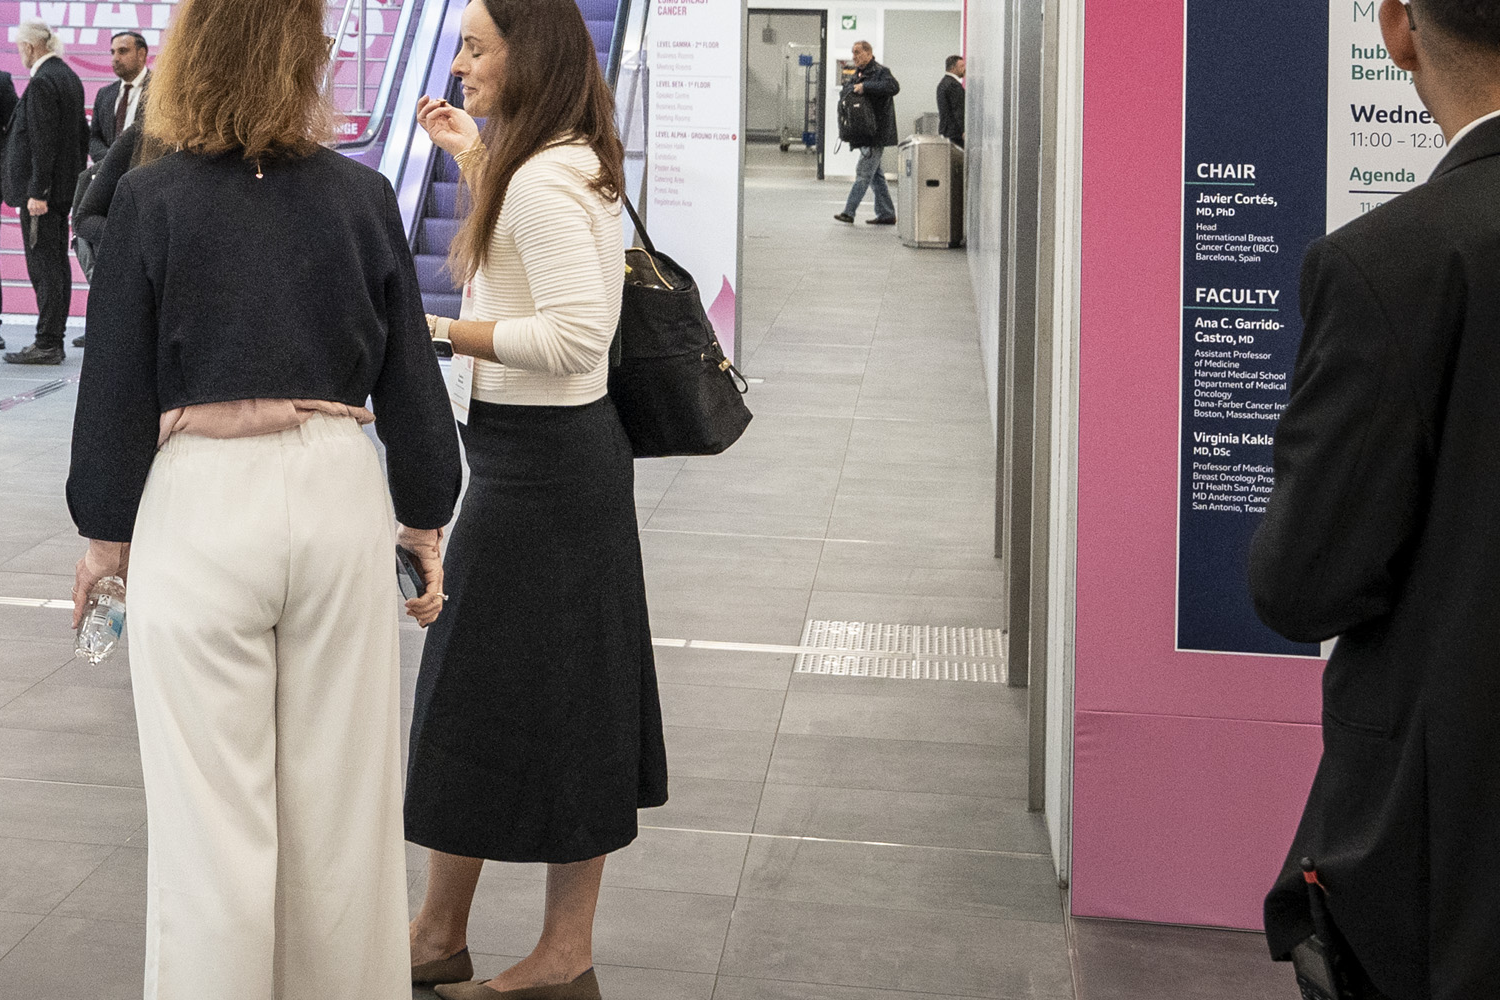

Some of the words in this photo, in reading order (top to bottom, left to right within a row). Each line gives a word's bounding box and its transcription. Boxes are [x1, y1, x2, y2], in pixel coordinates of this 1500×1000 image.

[657, 6, 687, 16] CANCER
[1352, 44, 1391, 59] hub
[1351, 65, 1414, 84] Berlin,
[1350, 132, 1392, 147] 11:00
[1410, 133, 1444, 149] 12:0
[1197, 163, 1256, 179] CHAIR
[1350, 167, 1415, 185] Agenda
[1196, 193, 1232, 204] Javier
[1235, 193, 1278, 207] Cortés,
[1196, 208, 1214, 218] MD,
[1216, 208, 1235, 217] PhD
[1196, 223, 1217, 231] Head
[1196, 233, 1246, 242] International
[1248, 234, 1274, 242] Breast
[1196, 243, 1223, 251] Cancer
[1225, 244, 1251, 252] Center
[1253, 244, 1279, 253] (IBCC)
[1196, 253, 1237, 262] Barcelona,
[1239, 254, 1261, 263] Spain
[1196, 288, 1280, 304] FACULTY
[1195, 318, 1218, 328] Ana
[1220, 318, 1232, 329] C.
[1235, 318, 1284, 330] Garrido-
[1195, 331, 1236, 345] Castro,
[1238, 335, 1254, 343] MD
[1195, 350, 1231, 358] Assistant
[1233, 351, 1271, 360] Professor
[1205, 360, 1240, 368] Medicine
[1194, 370, 1226, 378] Harvard
[1227, 371, 1258, 379] Medical
[1259, 372, 1286, 380] School
[1194, 379, 1244, 390] Department
[1245, 381, 1255, 389] of
[1256, 381, 1286, 390] Medical
[1194, 390, 1232, 400] Oncology
[1194, 400, 1244, 409] Dana-Farber
[1245, 401, 1273, 410] Cancer
[1194, 410, 1225, 419] Boston,
[1226, 411, 1280, 420] Massachusett
[1194, 432, 1239, 445] Virginia
[1242, 433, 1274, 445] Kakla
[1193, 447, 1211, 457] MD,
[1213, 448, 1231, 456] DSc
[1193, 462, 1231, 471] Professor
[1233, 463, 1242, 472] of
[1242, 464, 1274, 473] Medicin
[1193, 472, 1218, 481] Breast
[1219, 473, 1256, 484] Oncology
[1193, 483, 1204, 491] UT
[1206, 483, 1232, 492] Health
[1234, 484, 1250, 492] San
[1193, 493, 1206, 501] MD
[1208, 493, 1246, 502] Anderson
[1192, 502, 1208, 511] San
[1209, 503, 1242, 513] Antonio,
[1244, 504, 1266, 513] Texas
